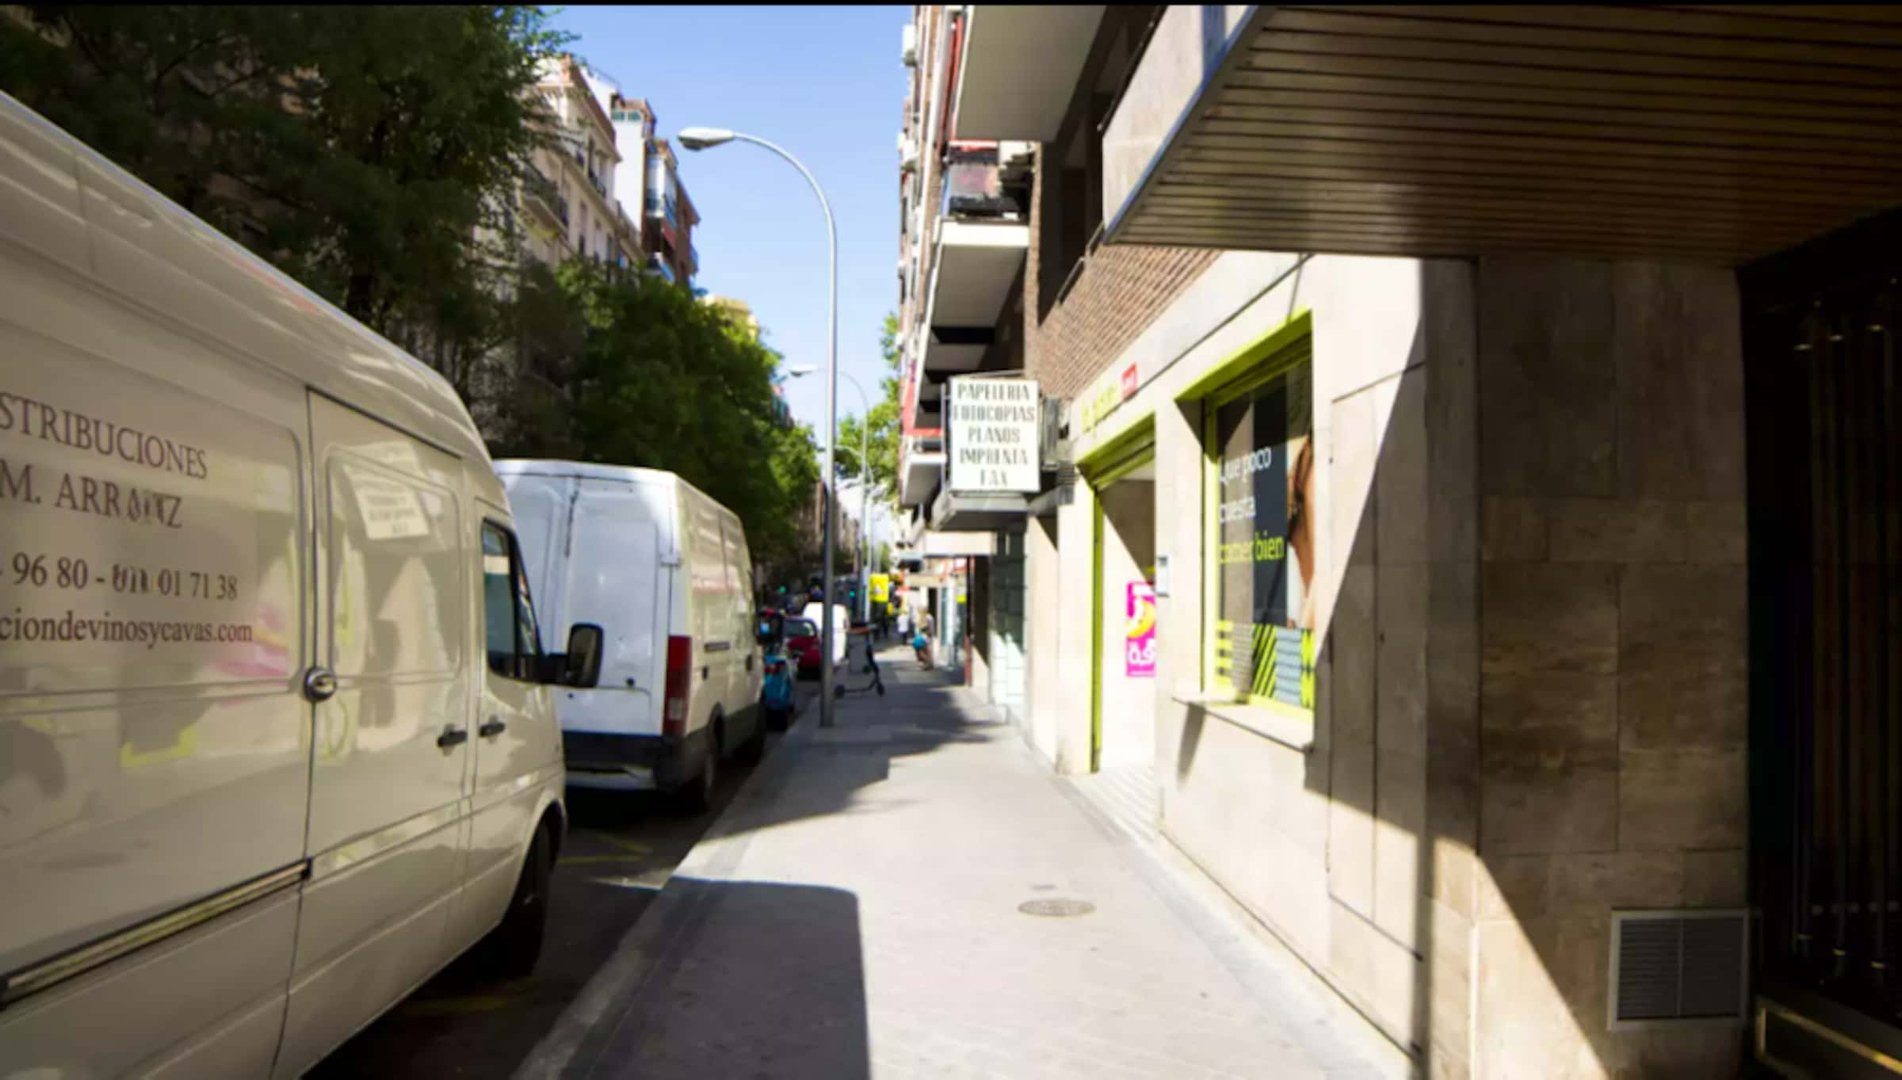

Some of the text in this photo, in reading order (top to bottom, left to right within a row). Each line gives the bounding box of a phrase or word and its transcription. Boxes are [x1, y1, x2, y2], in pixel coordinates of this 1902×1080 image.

[0, 392, 208, 480] STRIBUCIONES
[959, 447, 1029, 466] IMPRENTA
[967, 426, 1021, 444] PLANOS
[0, 458, 42, 505] M.
[1253, 529, 1285, 561] bien
[12, 551, 48, 588] 96
[56, 556, 89, 590] 80
[157, 568, 181, 597] 01
[189, 571, 209, 600] 71
[216, 573, 239, 602] 38
[0, 605, 254, 650] ciondevinosycavas.com
